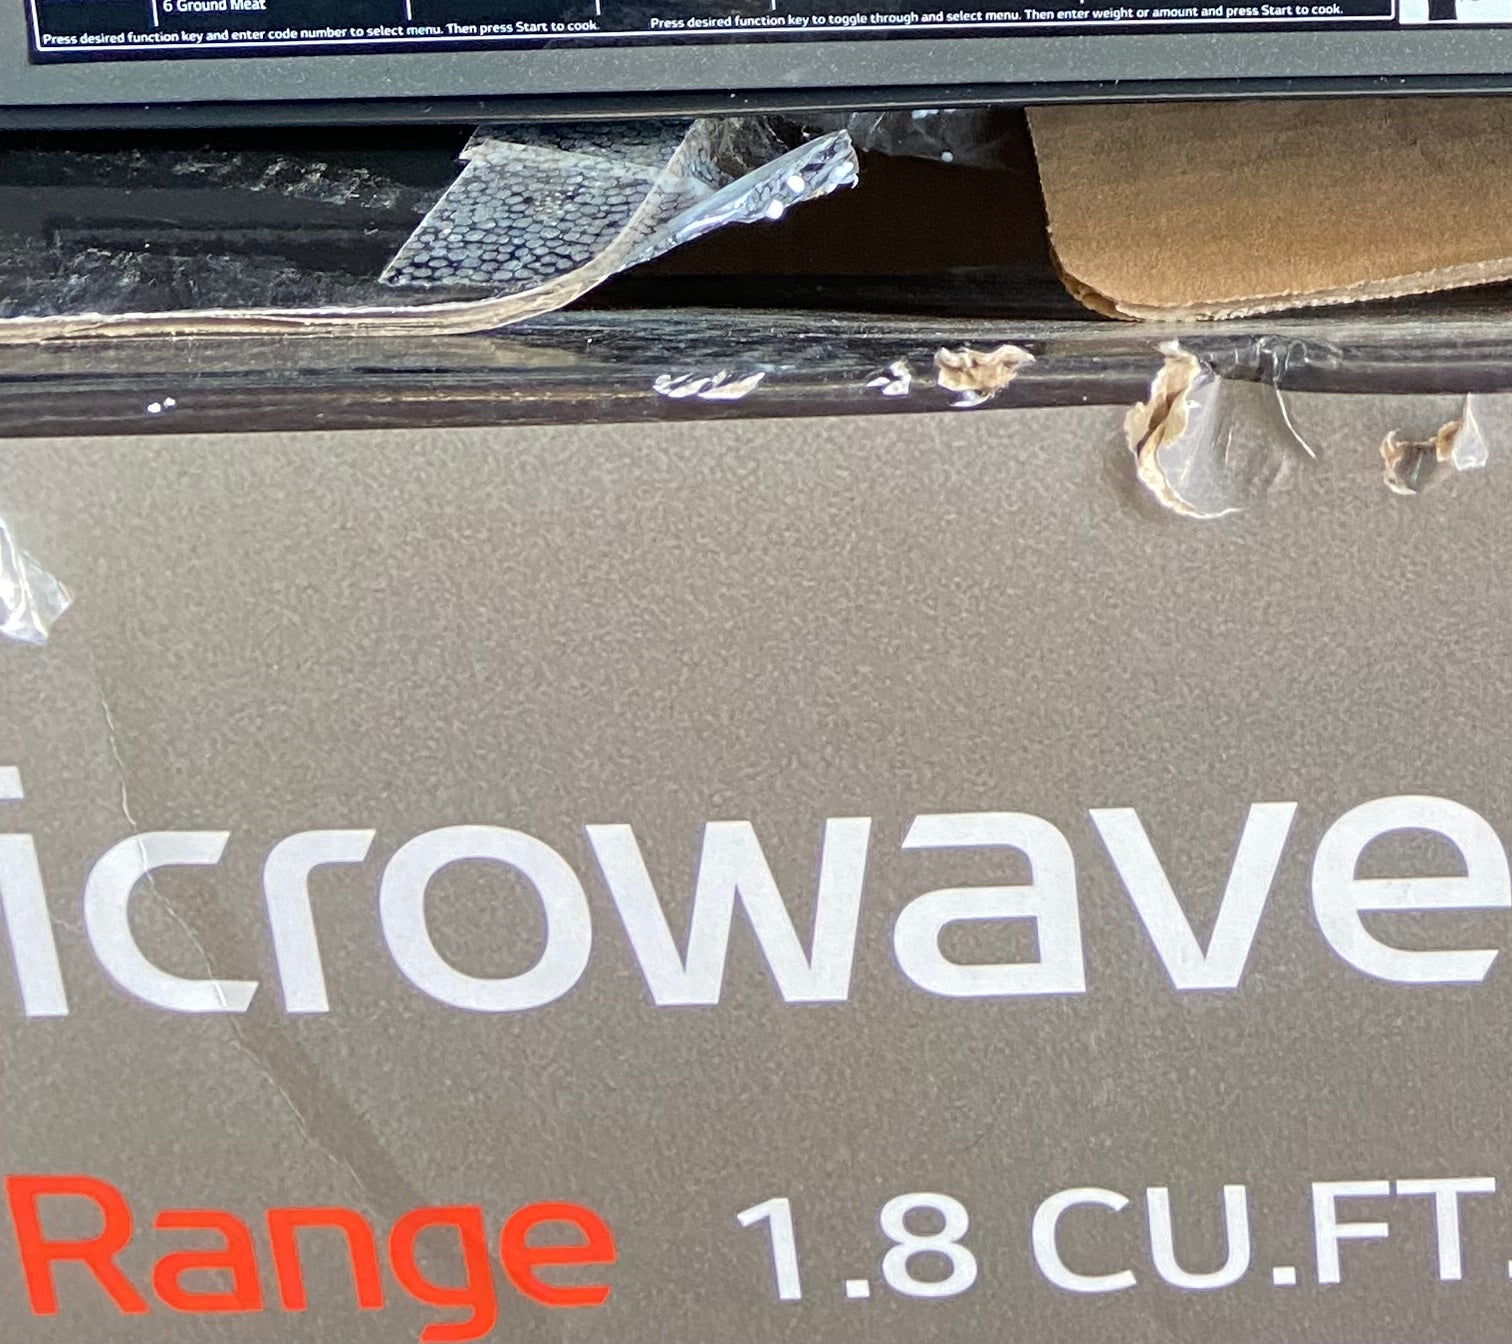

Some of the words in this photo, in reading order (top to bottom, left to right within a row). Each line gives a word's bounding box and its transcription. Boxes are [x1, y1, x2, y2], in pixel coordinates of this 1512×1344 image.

[163, 0, 173, 12] 6
[4, 1174, 617, 1343] Range
[737, 1192, 978, 1300] 1.8
